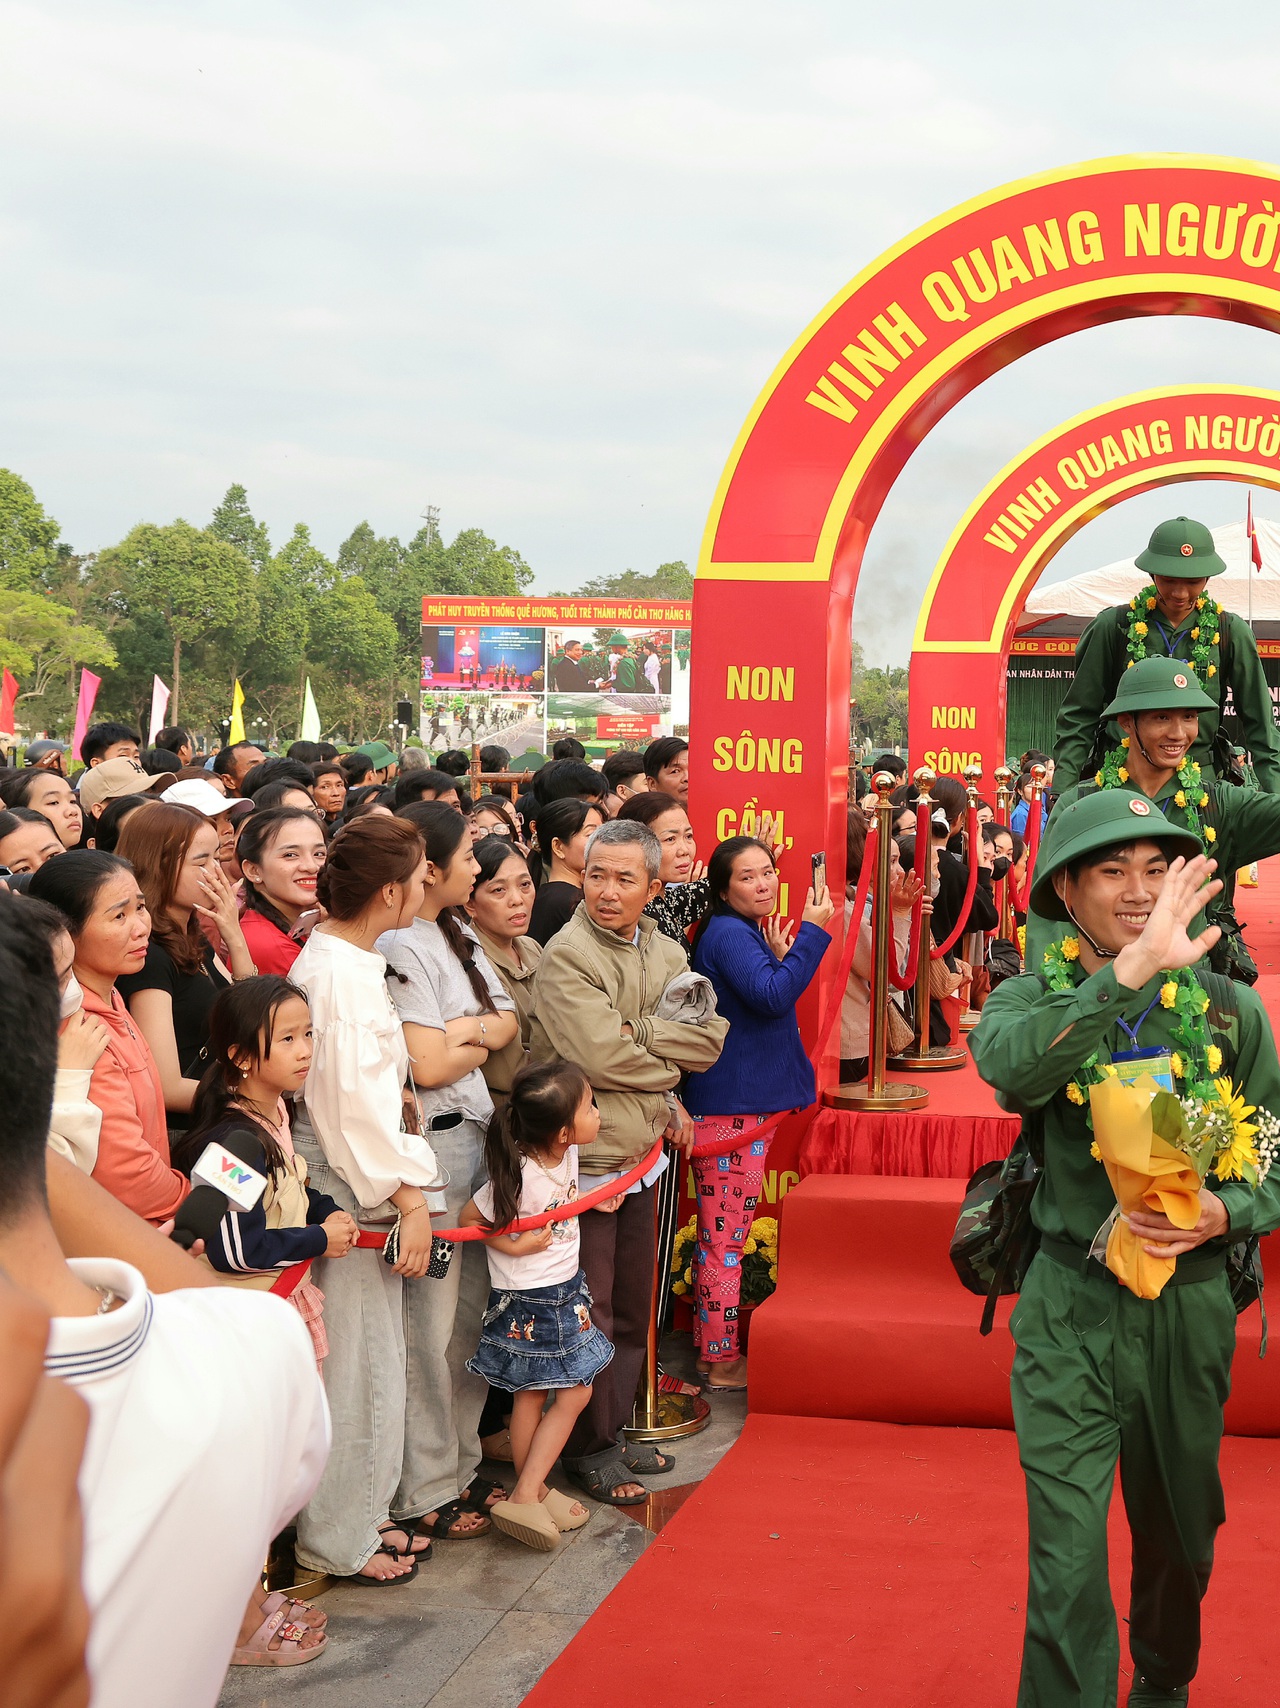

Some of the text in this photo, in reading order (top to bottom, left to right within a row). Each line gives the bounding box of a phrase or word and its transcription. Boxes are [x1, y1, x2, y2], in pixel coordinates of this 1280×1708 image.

[804, 301, 928, 424] VINH
[921, 210, 1105, 322] QUANG
[983, 475, 1062, 554] VINH
[1057, 419, 1174, 491] QUANG
[428, 602, 447, 616] PHÁT
[448, 605, 462, 617] HUY
[463, 602, 490, 617] TRUYỀN
[491, 602, 515, 618] THỐNG
[516, 603, 531, 620] QUÊ
[532, 605, 559, 620] HƯƠNG,
[560, 604, 578, 618] TUỔI
[579, 603, 592, 619] TRẺ
[593, 604, 617, 619] THÀNH
[618, 604, 632, 620] PHỐ
[634, 605, 648, 620] CẦN
[649, 608, 664, 620] THƠ
[665, 606, 684, 621] HĂNG
[726, 665, 795, 701] NON
[1020, 668, 1043, 678] NHÂN
[1044, 668, 1062, 678] DÂN
[931, 706, 976, 729] NON
[712, 729, 803, 774] SÔNG
[923, 746, 982, 774] SÔNG
[221, 1155, 253, 1185] VTV
